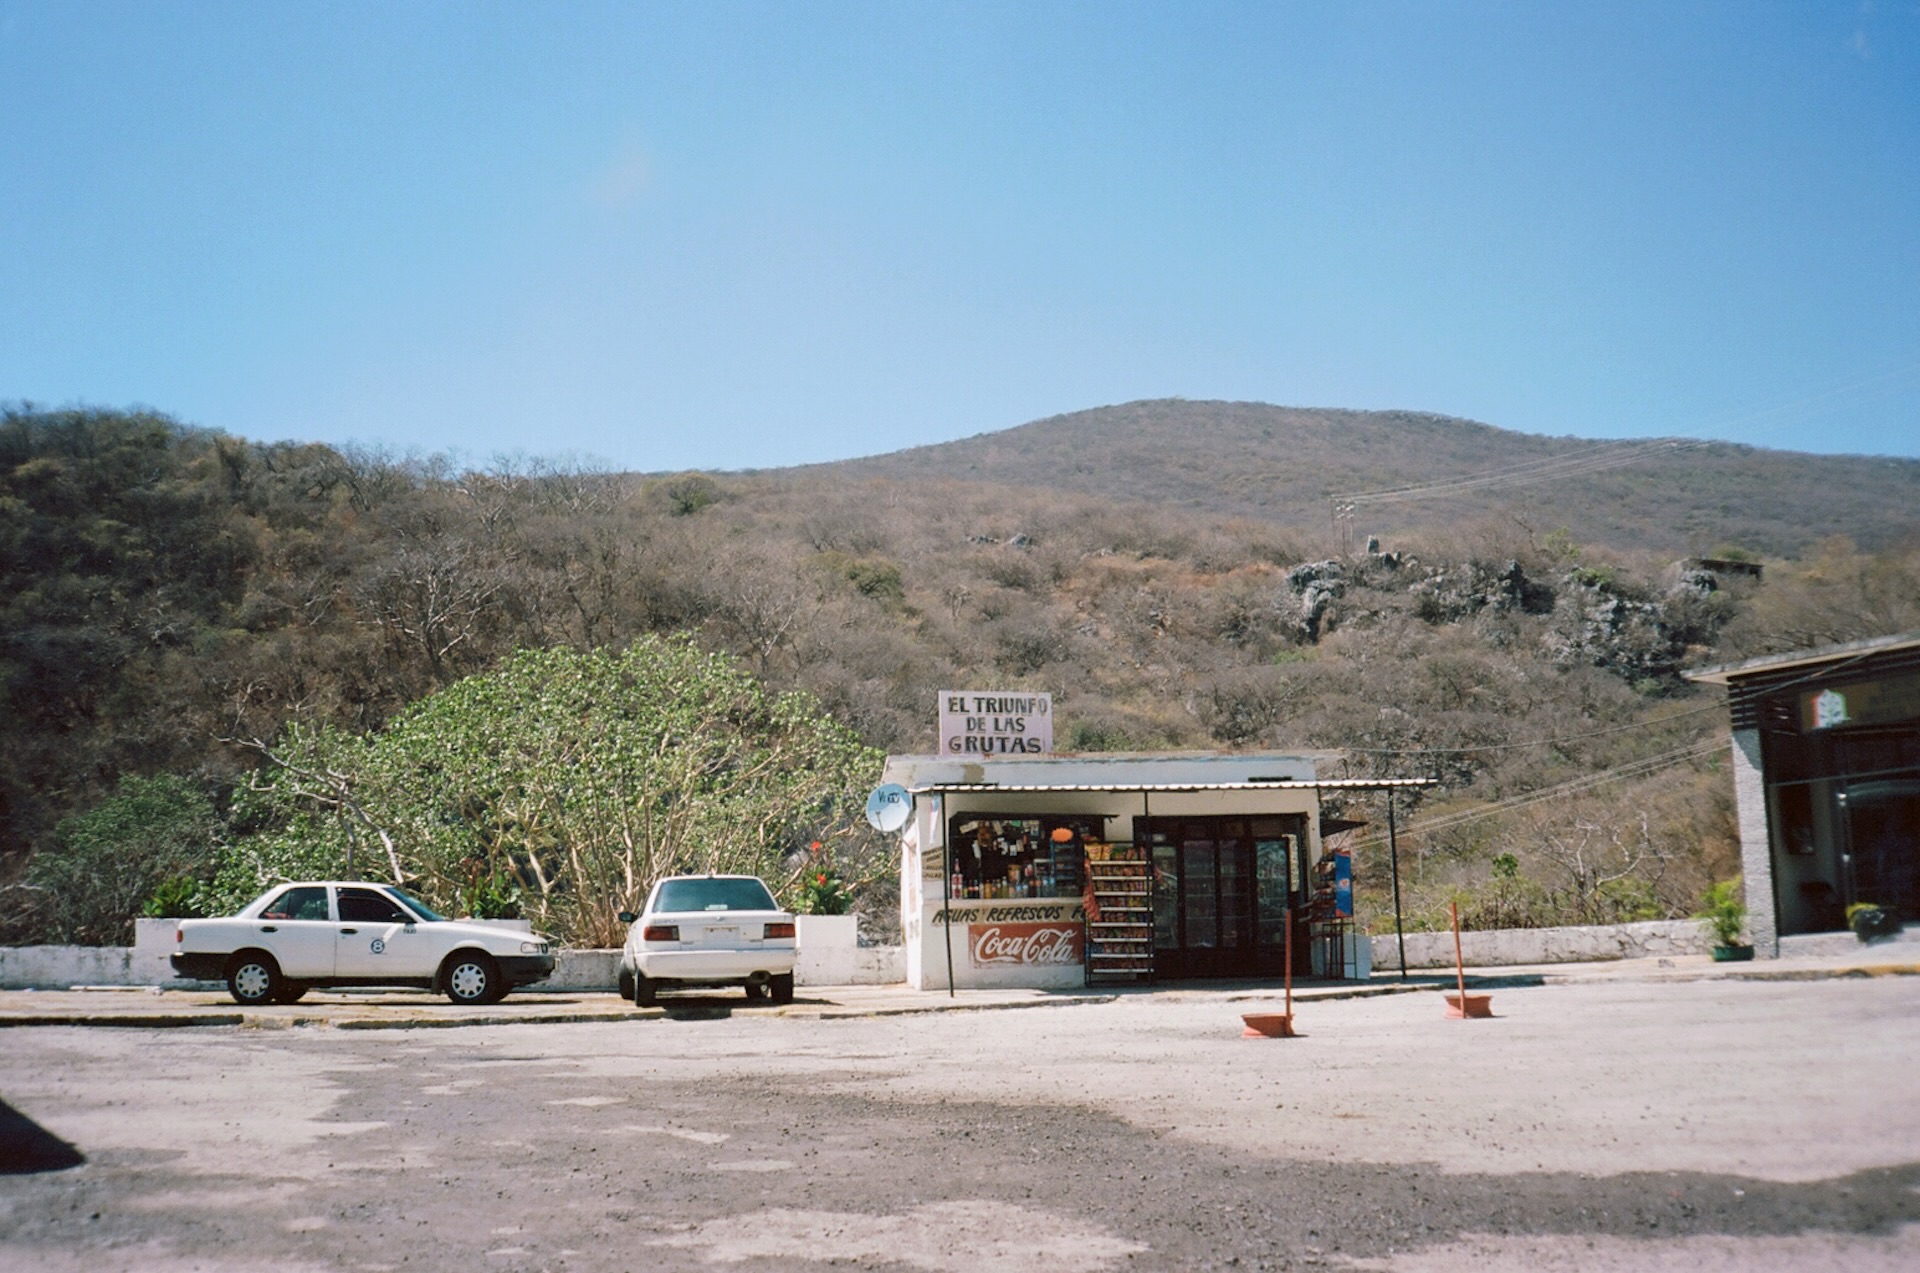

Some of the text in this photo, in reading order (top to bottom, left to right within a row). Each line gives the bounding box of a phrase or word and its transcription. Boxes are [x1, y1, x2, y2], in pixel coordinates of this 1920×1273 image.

[948, 696, 1048, 715] EL TRIUNFO
[966, 717, 1026, 732] DE LAS
[948, 736, 1042, 753] GRUTAS
[931, 908, 979, 924] AGUAS
[986, 906, 1063, 923] REFRESCOS
[372, 940, 384, 953] 8
[975, 927, 1078, 964] Coca-Cola
